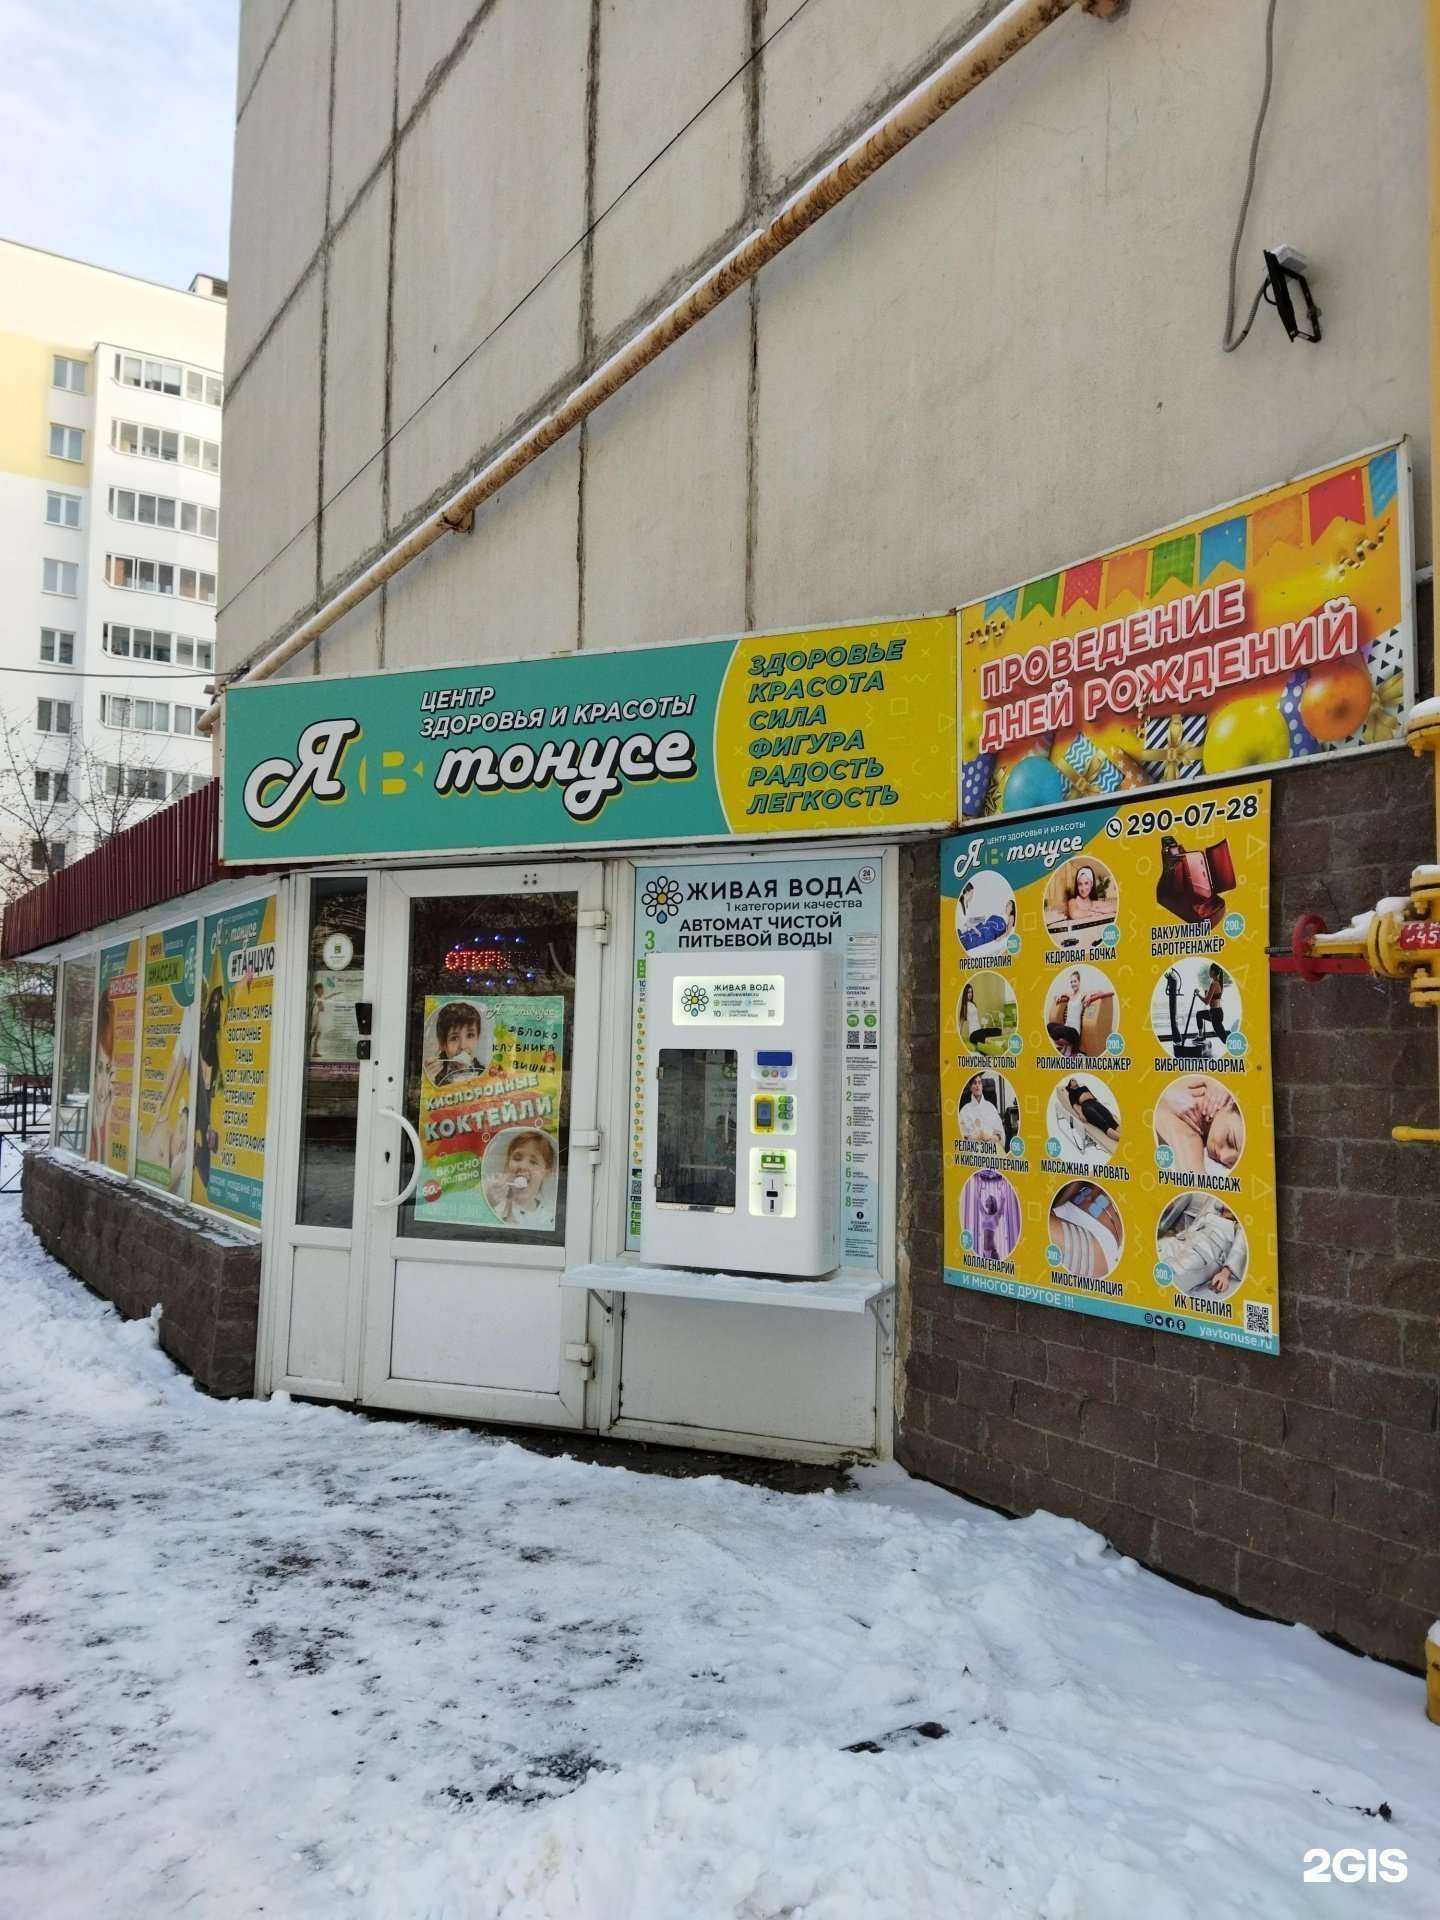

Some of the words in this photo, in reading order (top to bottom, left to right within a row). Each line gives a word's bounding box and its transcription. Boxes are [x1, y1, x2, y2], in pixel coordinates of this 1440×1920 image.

[980, 578, 1246, 701] ПРОВЕДЕНИЕ
[747, 639, 907, 677] ЗДОРОВЬЕ
[748, 671, 885, 703] КРАСОТА
[978, 680, 1074, 754] ДНЕЙ
[1083, 595, 1360, 721] РОЖДЕНИЙ
[420, 686, 496, 712] ЦЕНТР
[419, 706, 544, 739] ЗДОРОВЬЯ
[549, 704, 568, 726] И
[572, 694, 697, 725] КРАСОТЫ
[749, 704, 827, 731] СИЛА
[748, 729, 865, 759] ФИГУРА
[243, 718, 362, 828] Я
[433, 730, 698, 823] тонусе
[747, 757, 884, 788] РАДОСТЬ
[746, 785, 899, 815] ЛЕГКОСТЬ
[1127, 795, 1259, 836] 290-07-28
[1007, 829, 1042, 842] ЗДОРОВЬЯ
[1050, 821, 1086, 833] КРАСОТЫ
[953, 838, 984, 879] Я
[1006, 835, 1084, 868] тонусе
[687, 880, 778, 901] ЖИВАЯ
[789, 876, 863, 898] ВОДА
[726, 902, 731, 912] 1
[734, 899, 800, 913] категории
[803, 899, 862, 910] качества
[679, 916, 763, 932] АВТОМАТ
[768, 911, 842, 930] ЧИСТОЙ
[1151, 921, 1211, 941] ВАКУУМНЫЙ
[644, 929, 656, 951] 3
[678, 930, 772, 949] ПИТЬЕВОЙ
[777, 931, 832, 946] ВОДЫ
[231, 946, 275, 978] #ТАНЦУЮ
[959, 954, 1012, 971] ПРЕССОТЕРАПИЯ
[1045, 949, 1085, 965] КЕДРОВАЯ
[1089, 945, 1117, 962] БОЧКА
[713, 984, 746, 992] ЖИВАЯ
[749, 983, 775, 993] ВОДА
[508, 1026, 558, 1039] ЯБЛОКО
[492, 1044, 555, 1053] КЛУБНИКА
[513, 1061, 555, 1074] ВИШНЯ
[957, 1056, 992, 1069] ТОНУСНЫЕ
[993, 1055, 1017, 1069] СТОЛЫ
[1036, 1055, 1083, 1070] РОЛИКОВЫЙ
[1085, 1056, 1132, 1071] МАССАЖЕР
[1154, 1057, 1245, 1074] ВИБРОПЛАТФОРМА
[427, 1075, 539, 1111] КИСЛОРОДНЫЕ
[425, 1096, 552, 1141] КОКТЕЙЛИ
[954, 1140, 979, 1153] РЕЛАКС
[980, 1143, 997, 1155] ЗОНА
[954, 1154, 960, 1165] И
[960, 1155, 1029, 1173] КИСЛОРОДОТЕРАПИЯ
[1040, 1159, 1090, 1177] МАССАЖНАЯ
[1093, 1163, 1130, 1181] КРОВАТЬ
[1158, 1169, 1195, 1188] РУЧНОЙ
[1197, 1174, 1241, 1192] МАССАЖ
[963, 1254, 1015, 1275] КОЛЛАГЕНАРИЙ
[962, 1274, 970, 1285] И
[972, 1276, 1017, 1294] МНОГОЕ
[1017, 1287, 1061, 1305] ДРУГОЕ
[1051, 1271, 1124, 1297] МИОСТИМУЛЯЦИЯ
[1174, 1294, 1187, 1308] ИК
[1189, 1296, 1233, 1319] ТЕРАПИЯ
[1199, 1324, 1272, 1350] yavtonuse.ru
